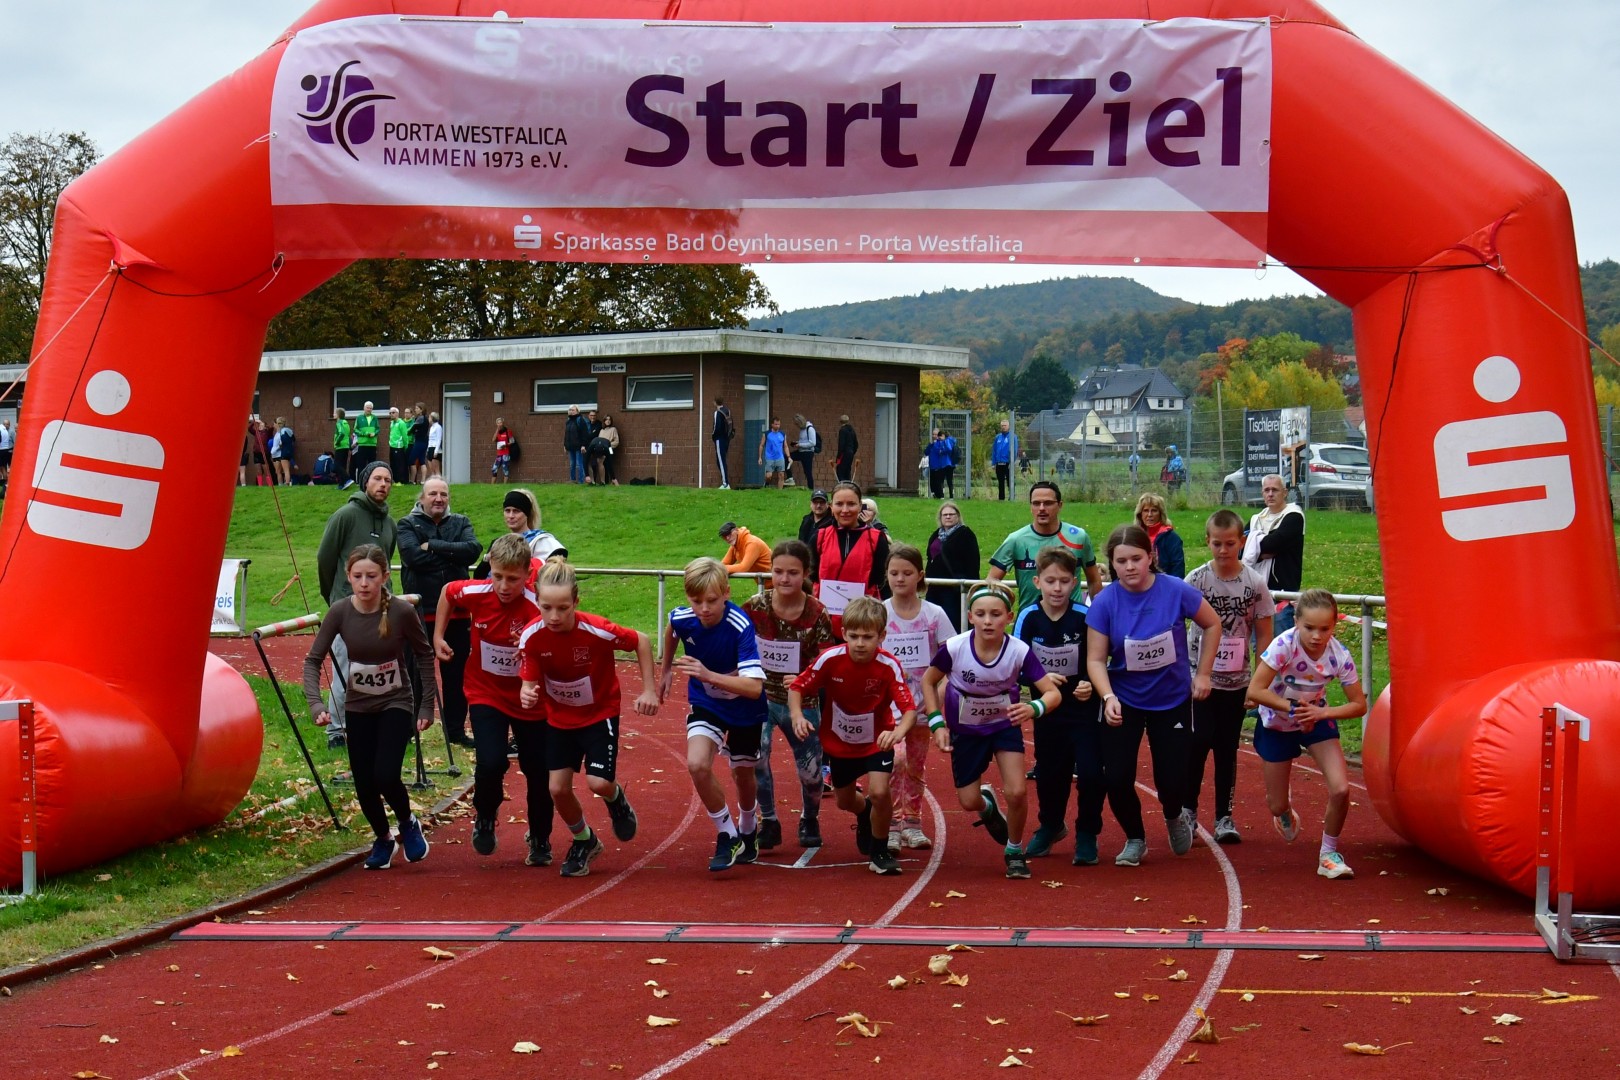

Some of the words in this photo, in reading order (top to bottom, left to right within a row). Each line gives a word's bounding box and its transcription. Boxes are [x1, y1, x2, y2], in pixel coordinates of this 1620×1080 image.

[625, 74, 918, 168] Start
[949, 73, 996, 167] /
[1026, 67, 1243, 167] Ziel
[384, 122, 447, 142] PORTA
[451, 125, 568, 146] WESTFALICA
[384, 147, 476, 168] NAMMEN
[483, 151, 524, 168] 1973
[531, 152, 568, 169] e.V.
[553, 231, 657, 253] Sparkasse
[666, 233, 705, 252] Bad
[712, 233, 838, 257] Oeynhausen
[859, 234, 912, 252] Porta
[918, 235, 1023, 253] Westfalica
[763, 650, 789, 662] 2432
[893, 645, 919, 656] 2431
[1137, 647, 1165, 661] 2429
[379, 662, 394, 671] 2437
[491, 655, 518, 667] 2427
[1041, 656, 1068, 668] 2430
[353, 670, 396, 687] 2437
[552, 688, 581, 699] 2428
[970, 707, 1000, 717] 2433
[838, 720, 863, 734] 2426
